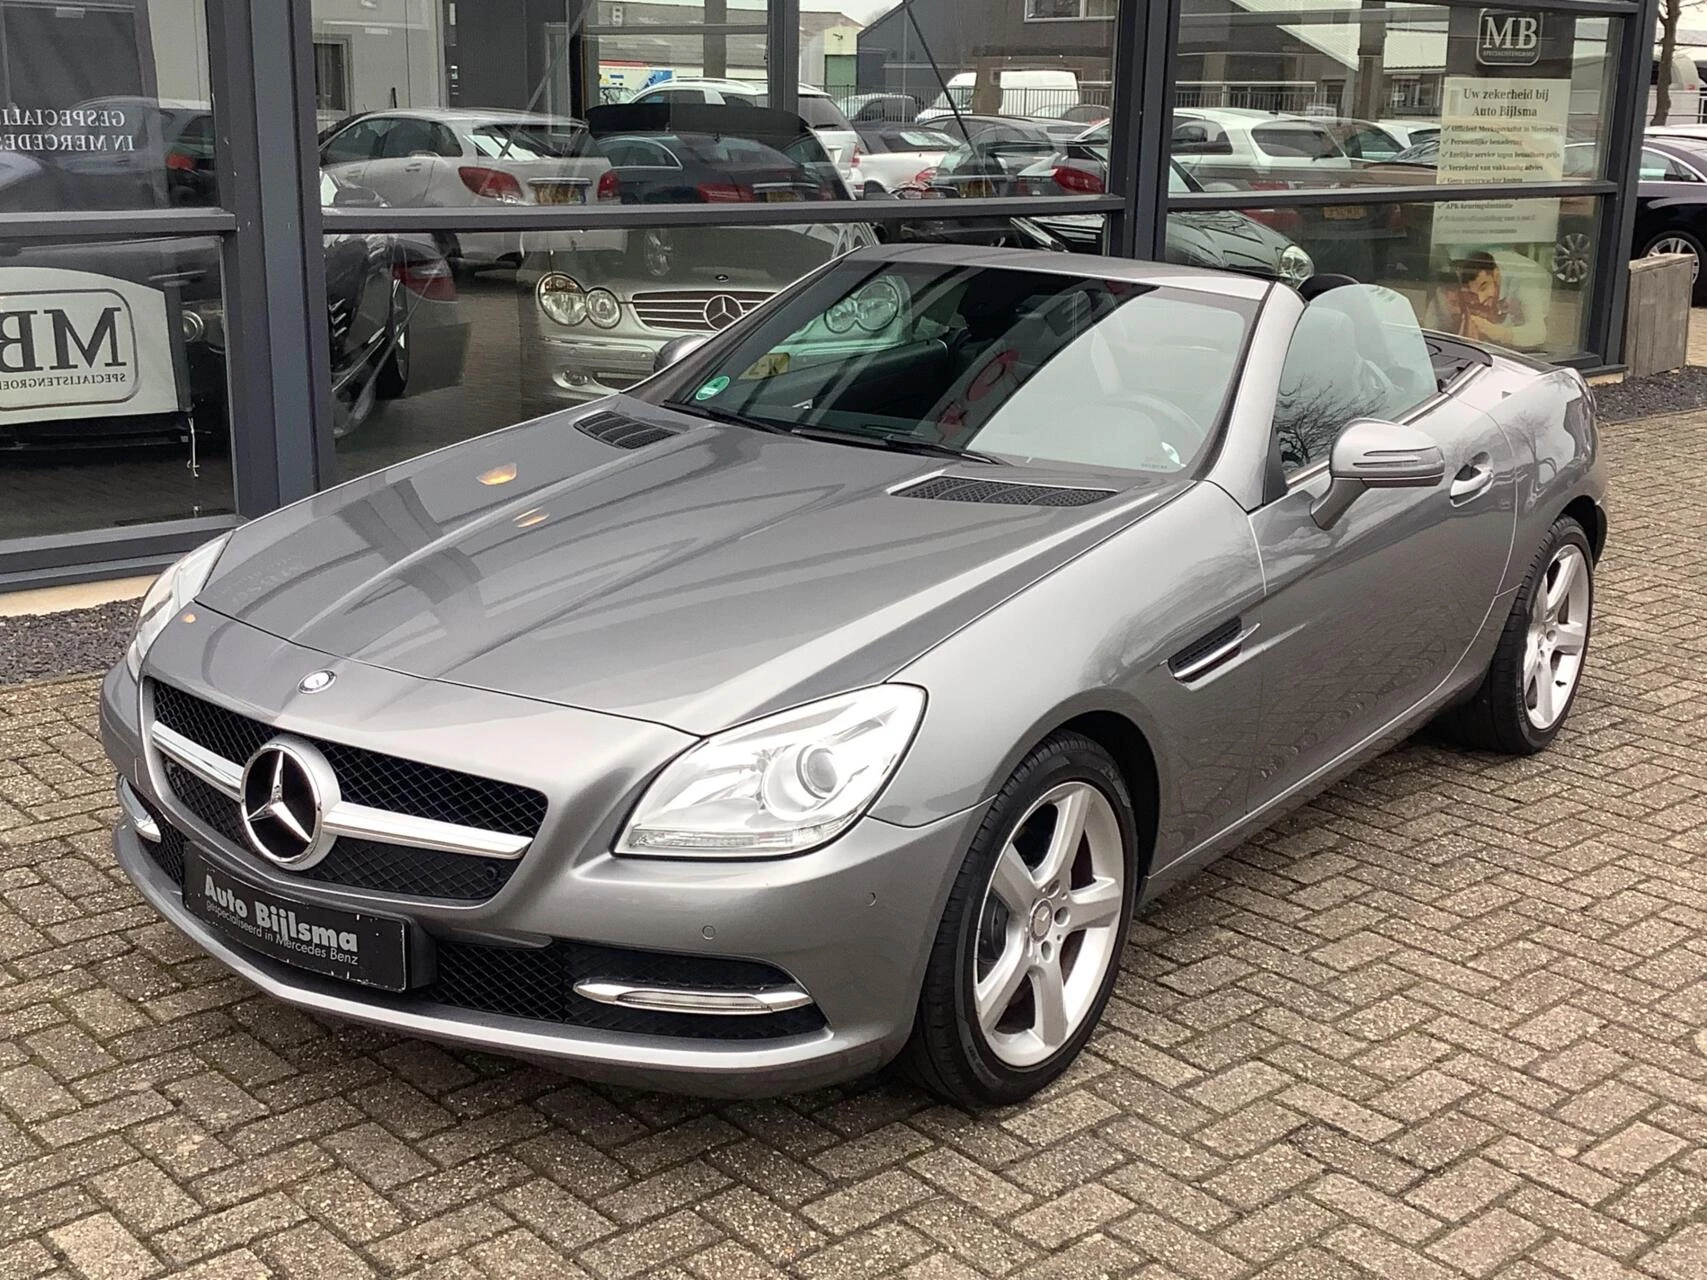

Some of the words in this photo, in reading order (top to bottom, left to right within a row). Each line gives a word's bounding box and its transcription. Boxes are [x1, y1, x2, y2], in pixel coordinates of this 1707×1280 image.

[1482, 16, 1538, 49] MB
[1463, 88, 1479, 100] Uw
[1482, 88, 1533, 101] zekerheid
[1535, 88, 1550, 102] bij
[1472, 105, 1497, 117] Auto
[1499, 105, 1537, 119] Bijlsma
[205, 874, 248, 918] Auto
[254, 901, 358, 952] Bijlsma
[264, 929, 273, 943] in
[275, 934, 326, 958] Mercedes
[330, 949, 359, 966] Benz
